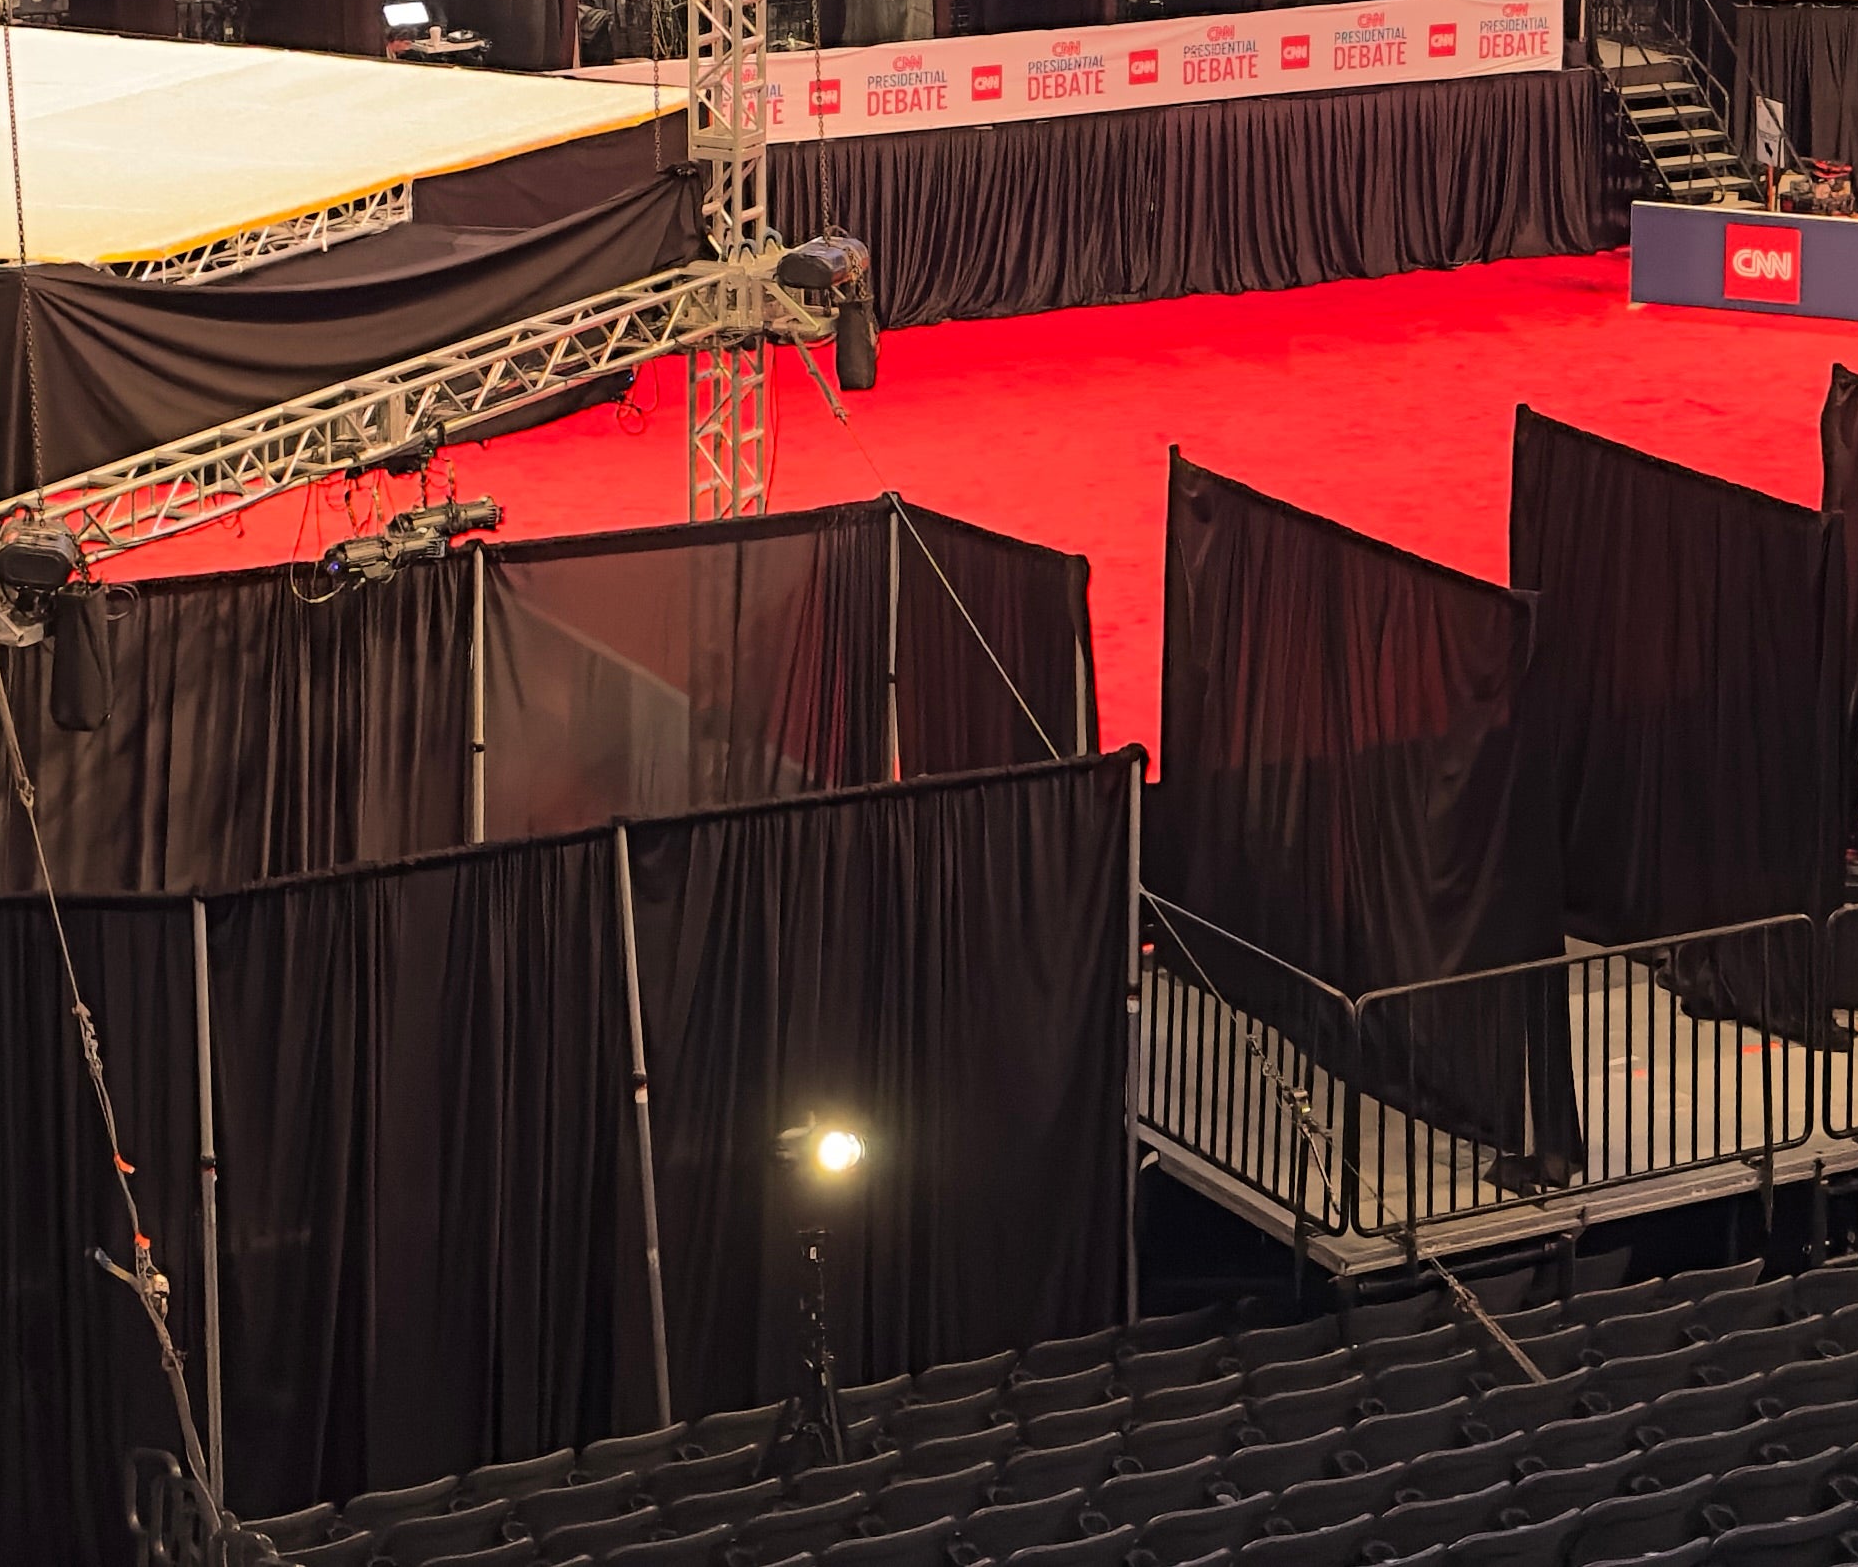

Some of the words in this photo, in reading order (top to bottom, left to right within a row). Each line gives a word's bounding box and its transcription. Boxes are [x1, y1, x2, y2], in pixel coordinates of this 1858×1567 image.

[1028, 55, 1105, 74] PRESIDENTIAL
[867, 71, 948, 89] PRESIDENTIAL
[1028, 69, 1106, 101] DEBATE
[867, 86, 948, 116] DEBATE
[1733, 248, 1792, 280] CNN
